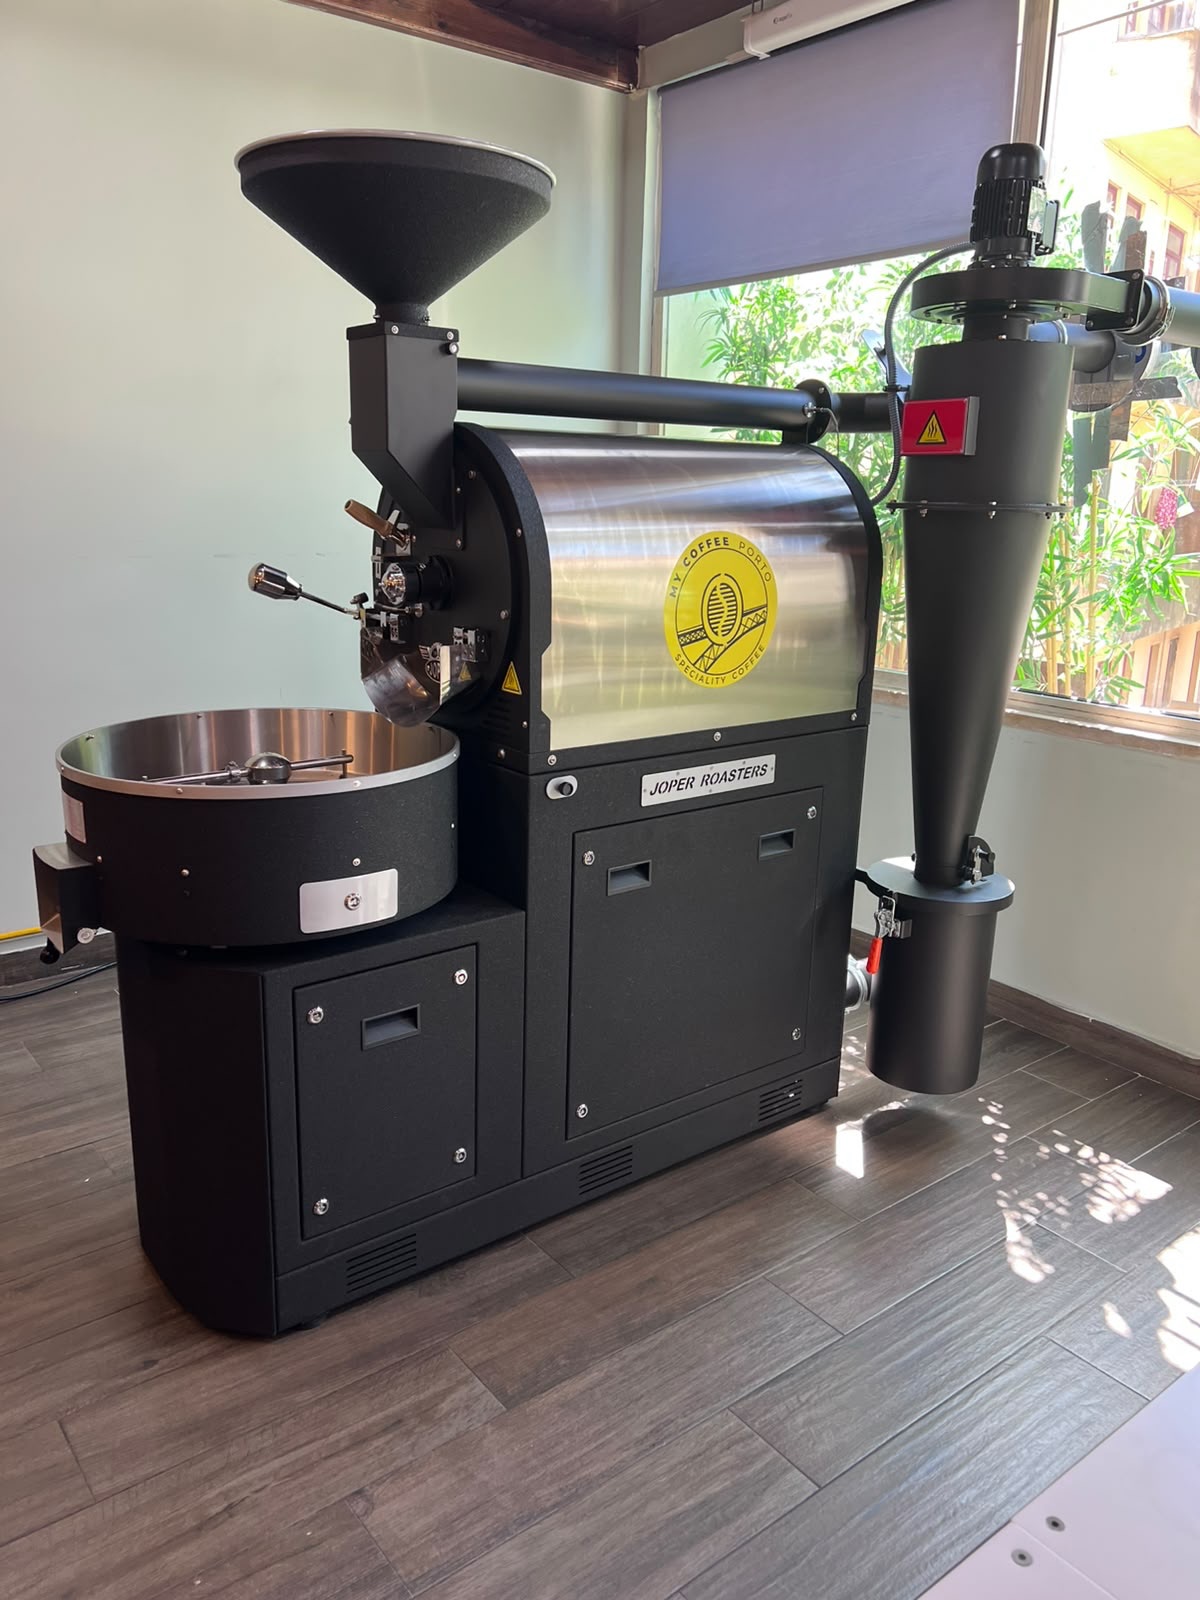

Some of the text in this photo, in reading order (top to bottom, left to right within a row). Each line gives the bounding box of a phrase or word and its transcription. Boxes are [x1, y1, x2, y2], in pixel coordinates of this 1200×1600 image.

[669, 536, 772, 598] MY COFFEE PORTO
[674, 645, 765, 685] SPECIALITY COFFEE
[650, 764, 768, 796] JOPER ROASTERS
